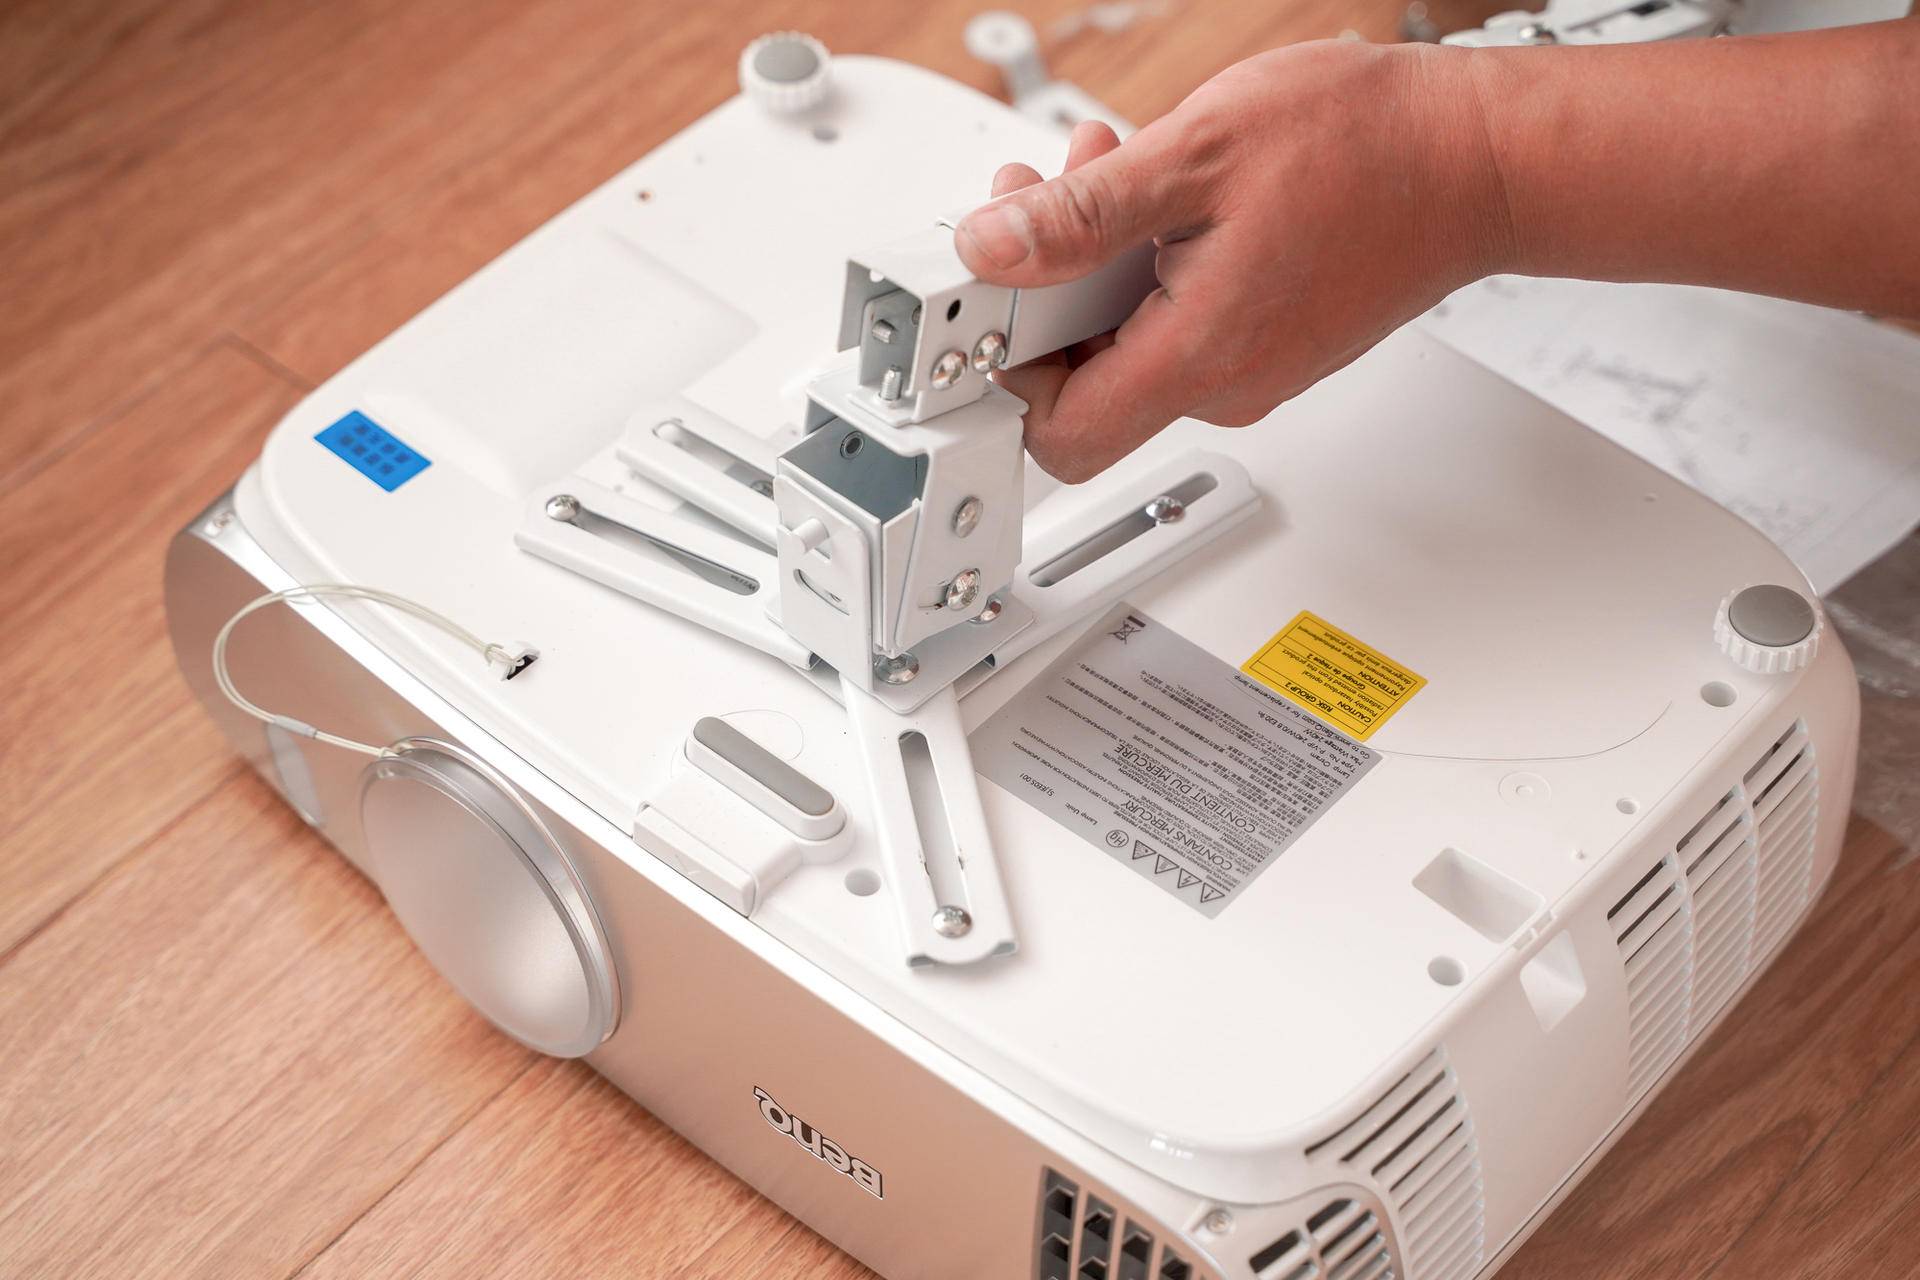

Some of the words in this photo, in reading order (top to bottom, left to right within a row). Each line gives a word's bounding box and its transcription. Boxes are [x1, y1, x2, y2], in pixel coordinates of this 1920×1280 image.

[1304, 662, 1318, 672] this
[1311, 656, 1333, 670] risque
[1301, 669, 1324, 684] optical
[1316, 669, 1333, 681] from
[1340, 672, 1367, 690] Groupe
[1357, 670, 1400, 697] ATTENTION
[1289, 684, 1317, 703] GROUP
[1322, 682, 1354, 702] hazardous
[1331, 678, 1357, 695] emitted
[1315, 700, 1333, 712] RISK
[1352, 699, 1379, 717] Possibly
[1355, 692, 1384, 711] radiation
[1289, 709, 1301, 718] for
[1336, 700, 1372, 723] CAUTION
[1349, 744, 1359, 752] to
[1357, 749, 1371, 759] Go
[1112, 743, 1171, 781] MERCURE
[1308, 751, 1331, 767] Osram
[1338, 759, 1358, 772] Type
[1169, 778, 1192, 794] DU
[1078, 811, 1099, 825] Lamp
[1120, 798, 1175, 835] MERCURY
[1189, 790, 1257, 834] CONTIENT
[1171, 830, 1234, 871] CONTAINS
[1218, 835, 1262, 863] AVERTISSEMENT
[753, 1085, 883, 1200] BenQ
